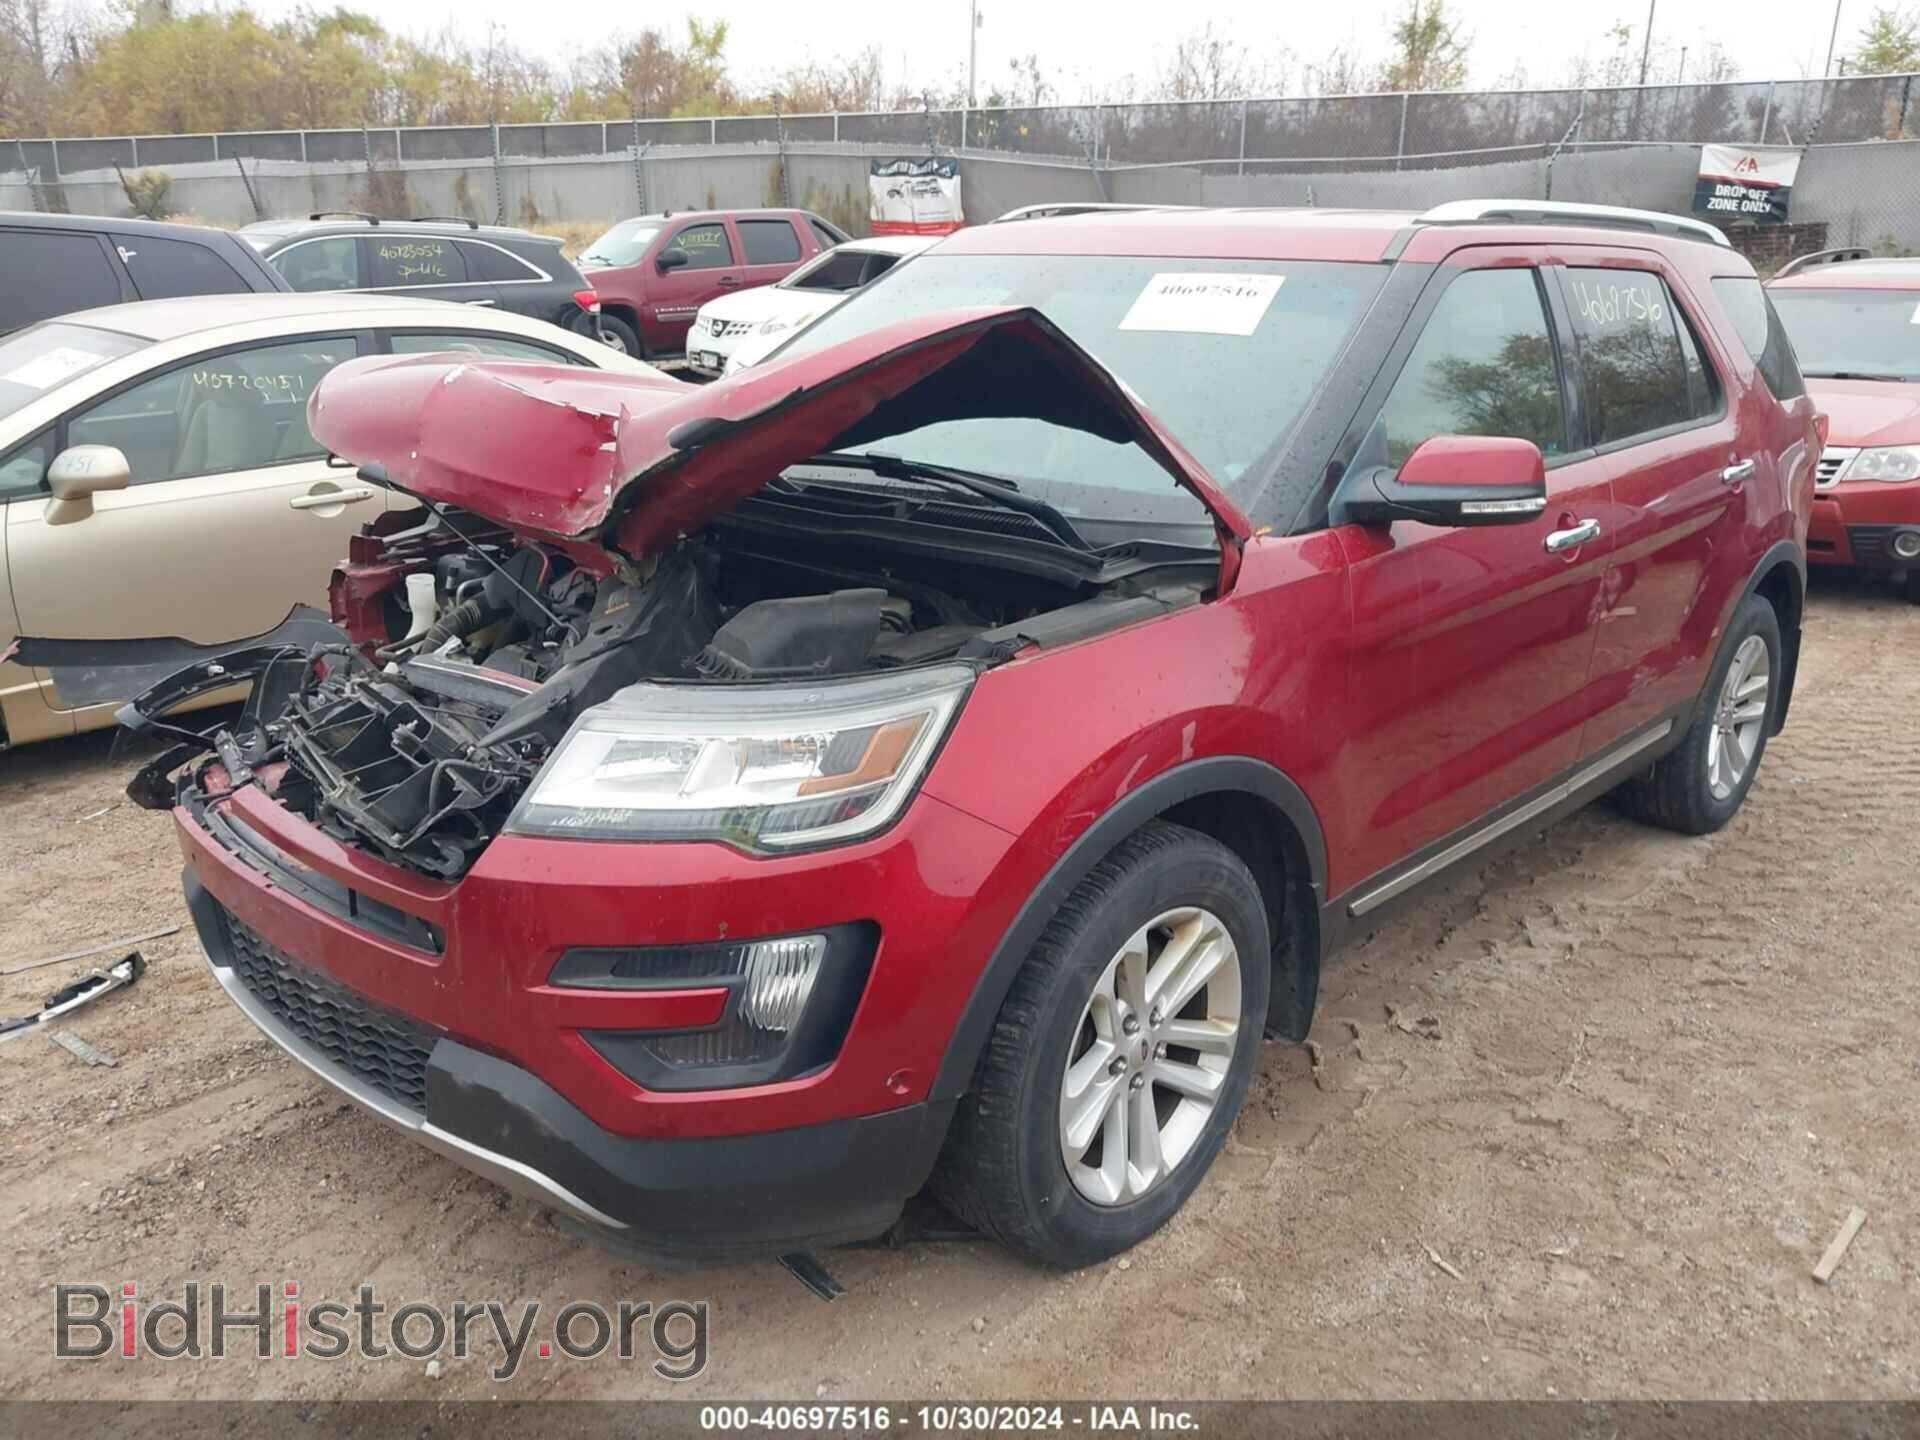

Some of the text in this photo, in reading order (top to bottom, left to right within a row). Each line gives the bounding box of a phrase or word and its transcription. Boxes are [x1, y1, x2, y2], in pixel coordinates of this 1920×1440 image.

[1715, 183, 1769, 201] DROP OFF
[1706, 197, 1772, 213] ZONE ONLY
